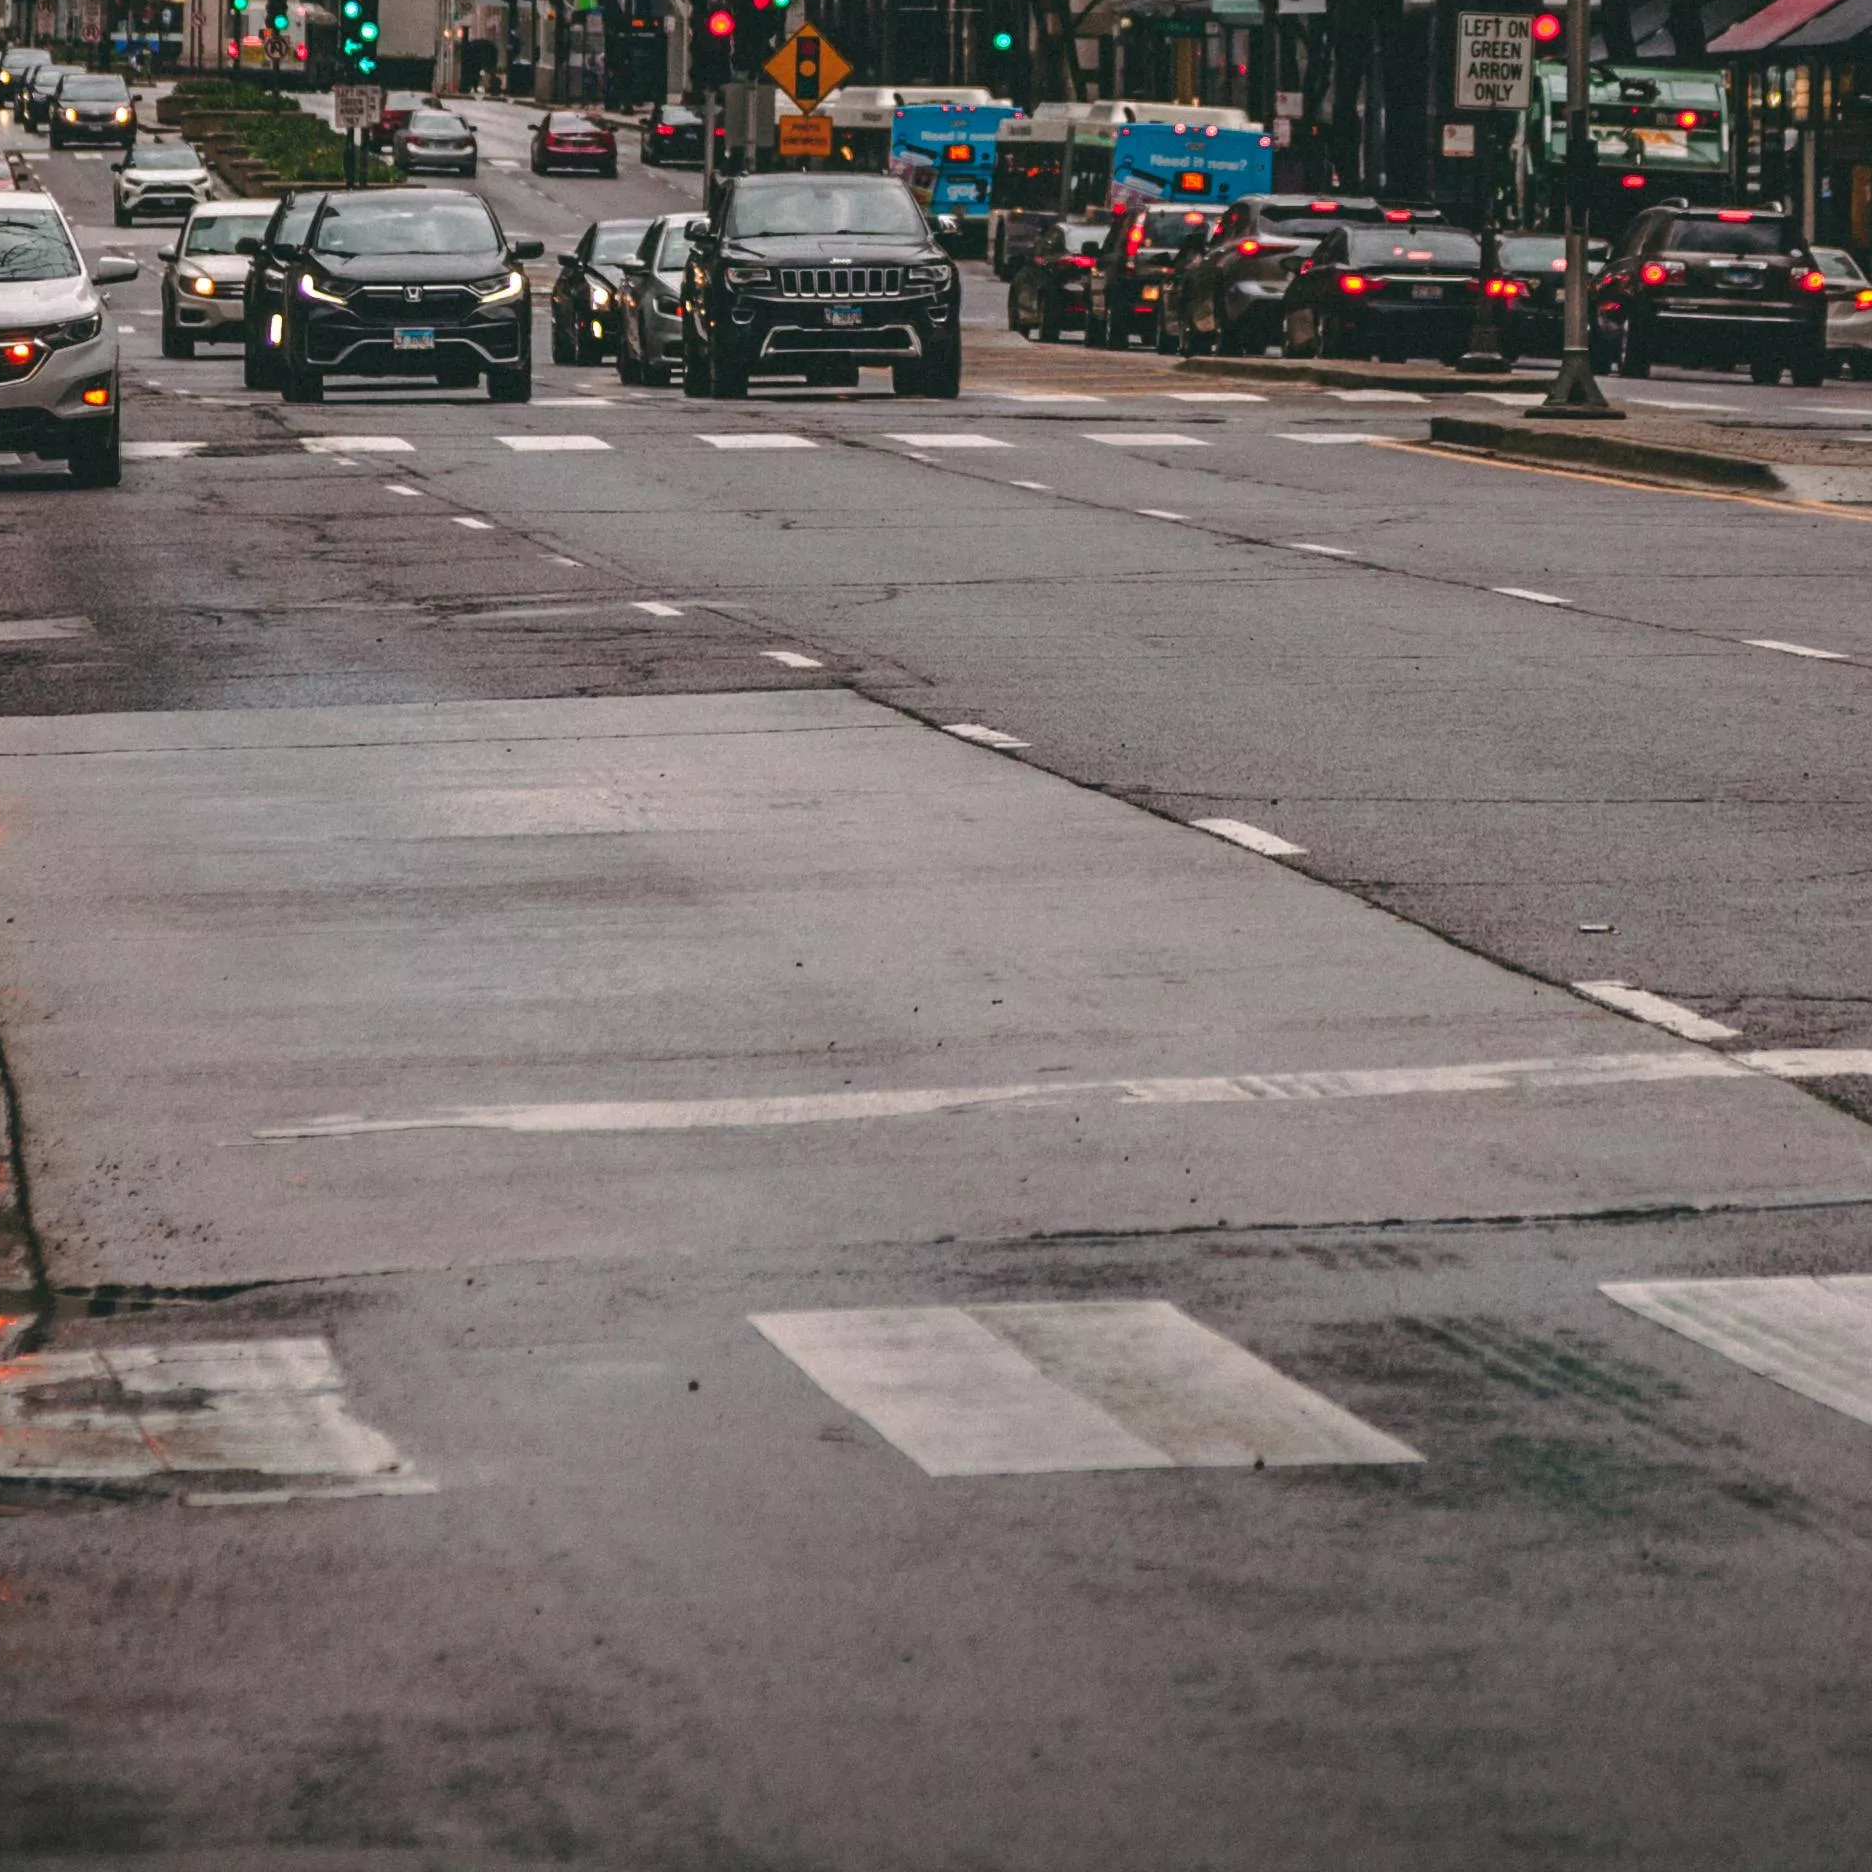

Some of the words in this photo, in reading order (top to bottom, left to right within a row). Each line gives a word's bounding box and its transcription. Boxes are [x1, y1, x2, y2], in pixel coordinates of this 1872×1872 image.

[1464, 19, 1500, 38] LEFT
[1508, 20, 1529, 38] ON
[1470, 41, 1522, 59] GREEN
[1468, 62, 1523, 81] ARROW
[1474, 83, 1514, 101] ONLY
